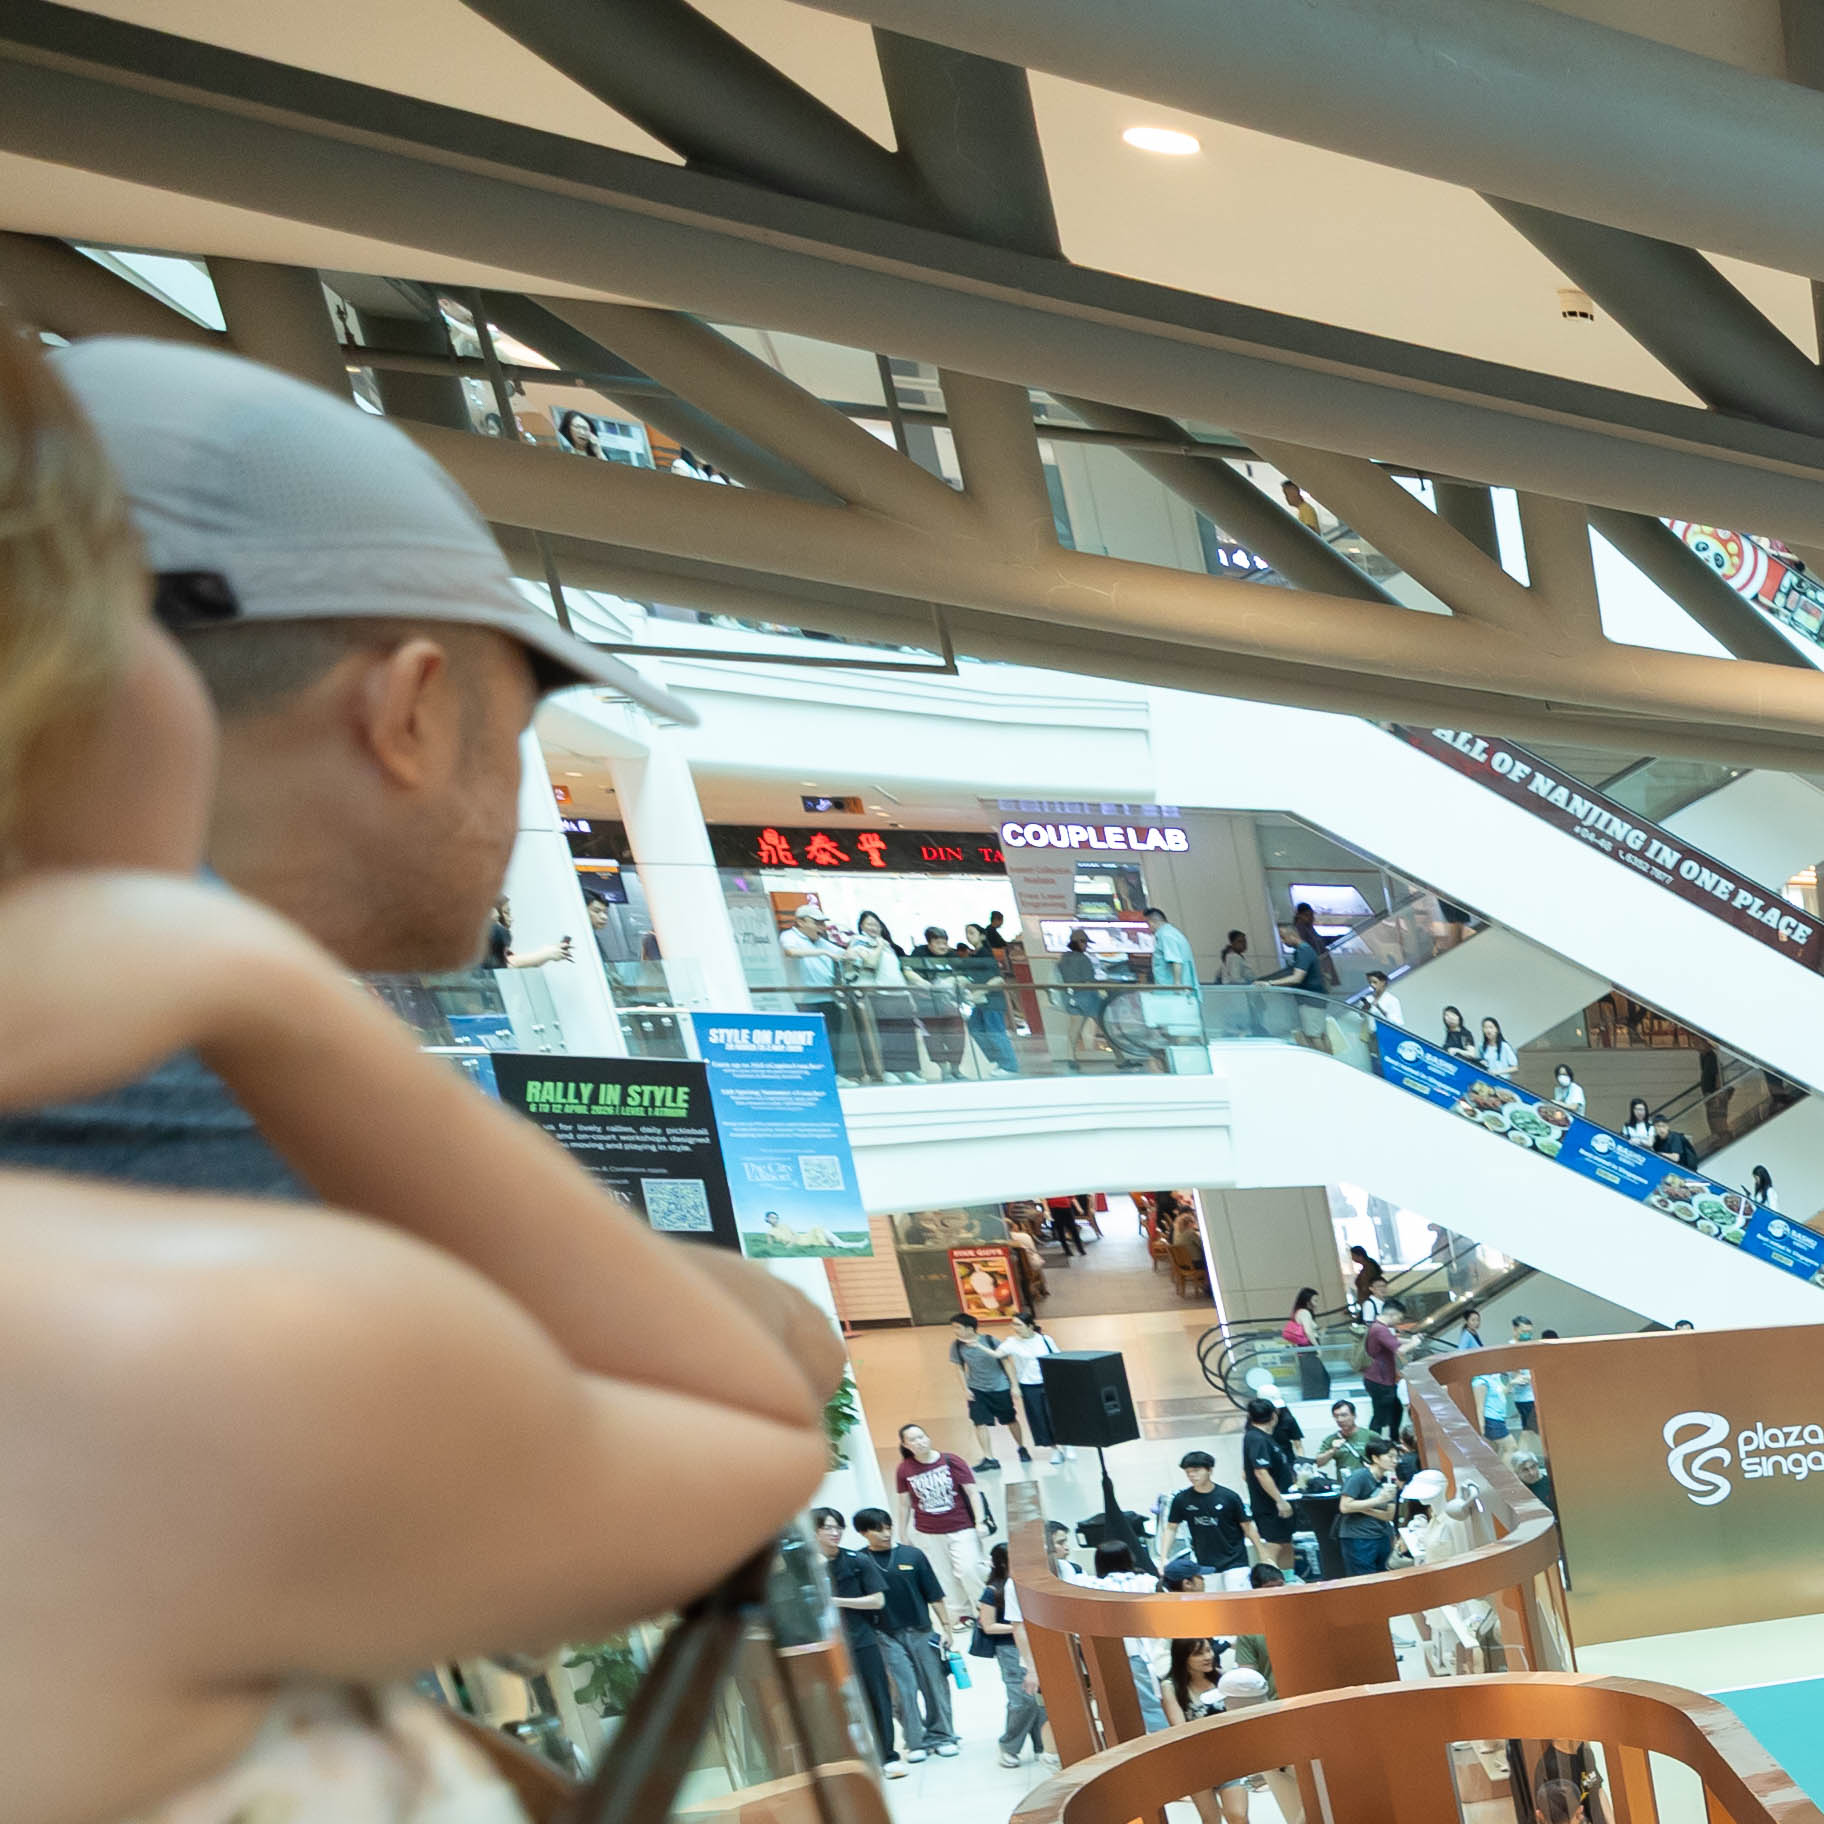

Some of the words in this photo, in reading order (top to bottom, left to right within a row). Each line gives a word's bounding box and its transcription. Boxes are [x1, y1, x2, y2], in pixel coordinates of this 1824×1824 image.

[1002, 821, 1128, 850] COUPLE
[1127, 826, 1190, 852] LAB
[1432, 728, 1492, 763] ALL
[1490, 752, 1532, 783] OF
[1527, 772, 1648, 852] NANJING
[1645, 838, 1682, 871] IN
[1679, 859, 1737, 901] ONE
[1731, 888, 1813, 945] PLACE
[921, 846, 964, 862] DIN
[978, 847, 1005, 863] TA
[709, 1028, 750, 1044] STYLE
[752, 1029, 773, 1044] ON
[775, 1030, 816, 1046] POINT
[526, 1081, 594, 1104] RALLY
[599, 1084, 622, 1105] IN
[627, 1085, 690, 1108] STYLE
[1738, 1421, 1824, 1459] plaza
